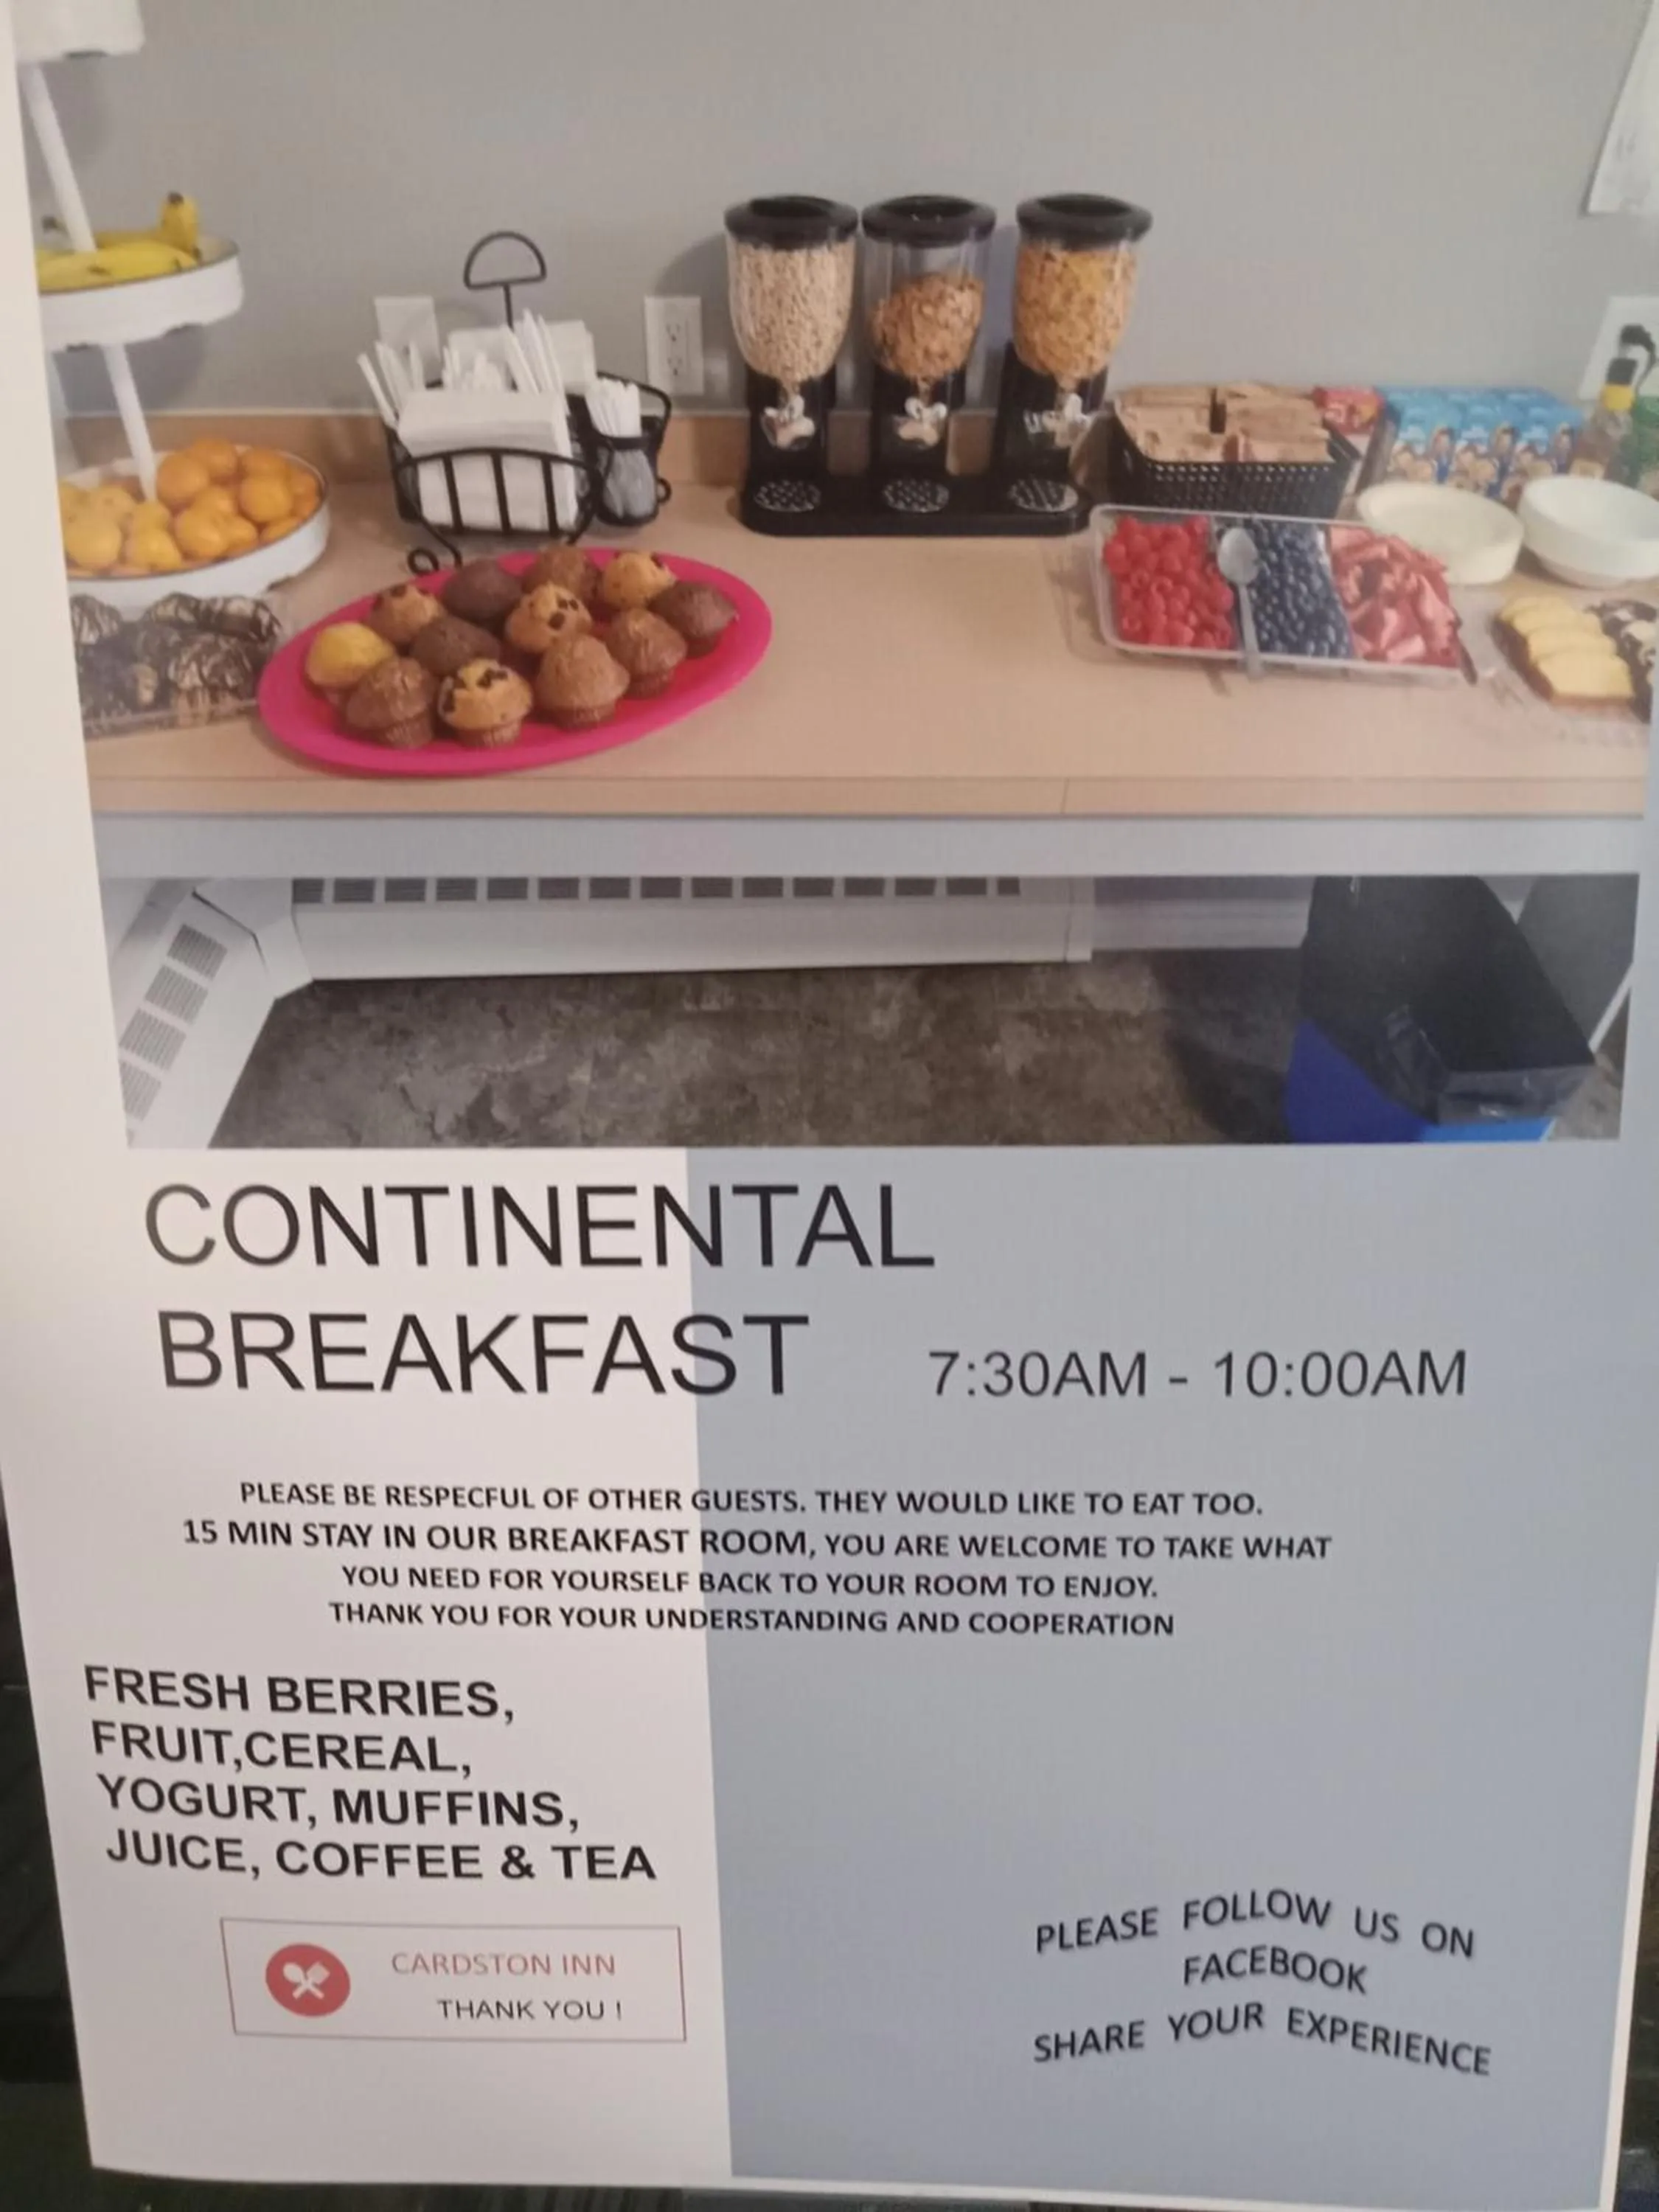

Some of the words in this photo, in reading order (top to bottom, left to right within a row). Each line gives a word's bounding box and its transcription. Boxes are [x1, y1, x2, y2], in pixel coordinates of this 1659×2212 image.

[146, 1184, 934, 1267] CONTINENTAL
[159, 1311, 809, 1395] BREAKFAST
[929, 1351, 1146, 1397] 7:30AM
[1215, 1350, 1466, 1397] 10:00AM
[241, 1482, 335, 1505] PLEASE
[344, 1485, 375, 1506] BE
[386, 1486, 535, 1509] RESPECFUL
[543, 1488, 578, 1509] OF
[588, 1489, 681, 1510] OTHER
[691, 1489, 805, 1512] GUESTS.
[815, 1491, 887, 1512] THEY
[897, 1492, 1008, 1514] WOULD
[1018, 1492, 1074, 1514] LIKE
[1085, 1493, 1123, 1514] TO
[1133, 1493, 1184, 1514] EAT
[1192, 1493, 1262, 1514] TOO.
[184, 1520, 218, 1544] 15
[229, 1521, 292, 1545] MIN
[303, 1523, 372, 1548] STAY
[384, 1525, 415, 1548] IN
[427, 1526, 497, 1550] OUR
[509, 1528, 689, 1553] BREAKFAST
[700, 1529, 815, 1559] ROOM,
[825, 1534, 884, 1556] YOU
[894, 1535, 948, 1557] ARE
[959, 1536, 1106, 1558] WELCOME
[1116, 1537, 1155, 1558] TO
[1164, 1537, 1233, 1558] TAKE
[1243, 1537, 1332, 1558] WHAT
[342, 1566, 398, 1587] YOU
[408, 1568, 480, 1588] NEED
[490, 1569, 543, 1590] FOR
[552, 1571, 688, 1592] YOURSELF
[699, 1572, 771, 1593] BACK
[780, 1573, 818, 1594] TO
[827, 1573, 905, 1595] YOUR
[915, 1575, 1006, 1596] ROOM
[1017, 1576, 1054, 1597] TO
[1065, 1576, 1157, 1598] ENJOY.
[330, 1602, 422, 1624] THANK
[431, 1604, 488, 1625] YOU
[498, 1606, 552, 1627] FOR
[560, 1607, 636, 1627] YOUR
[646, 1608, 887, 1632] UNDERSTANDING
[897, 1612, 959, 1632] AND
[969, 1613, 1173, 1635] COOPERATION
[85, 1665, 248, 1711] FRESH
[268, 1677, 513, 1724] BERRIES,
[97, 1773, 316, 1829] YOGURT,
[333, 1789, 577, 1833] MUFFINS,
[107, 1829, 260, 1879] JUICE,
[276, 1840, 483, 1879] COFFEE
[501, 1845, 535, 1879] &
[552, 1846, 656, 1879] TEA
[1037, 1907, 1158, 1954] PLEASE
[1183, 1889, 1332, 1930] FOLLOW
[1354, 1907, 1399, 1943] US
[1422, 1922, 1473, 1958] ON
[392, 1953, 552, 1975] CARDSTON
[563, 1954, 615, 1975] INN
[1184, 1945, 1366, 1994] FACEBOOK
[438, 2000, 535, 2020] THANK
[543, 2000, 604, 2020] YOU
[1034, 2020, 1144, 2062] SHARE
[1168, 2002, 1263, 2042] YOUR
[1287, 2006, 1490, 2076] EXPERIENCE
